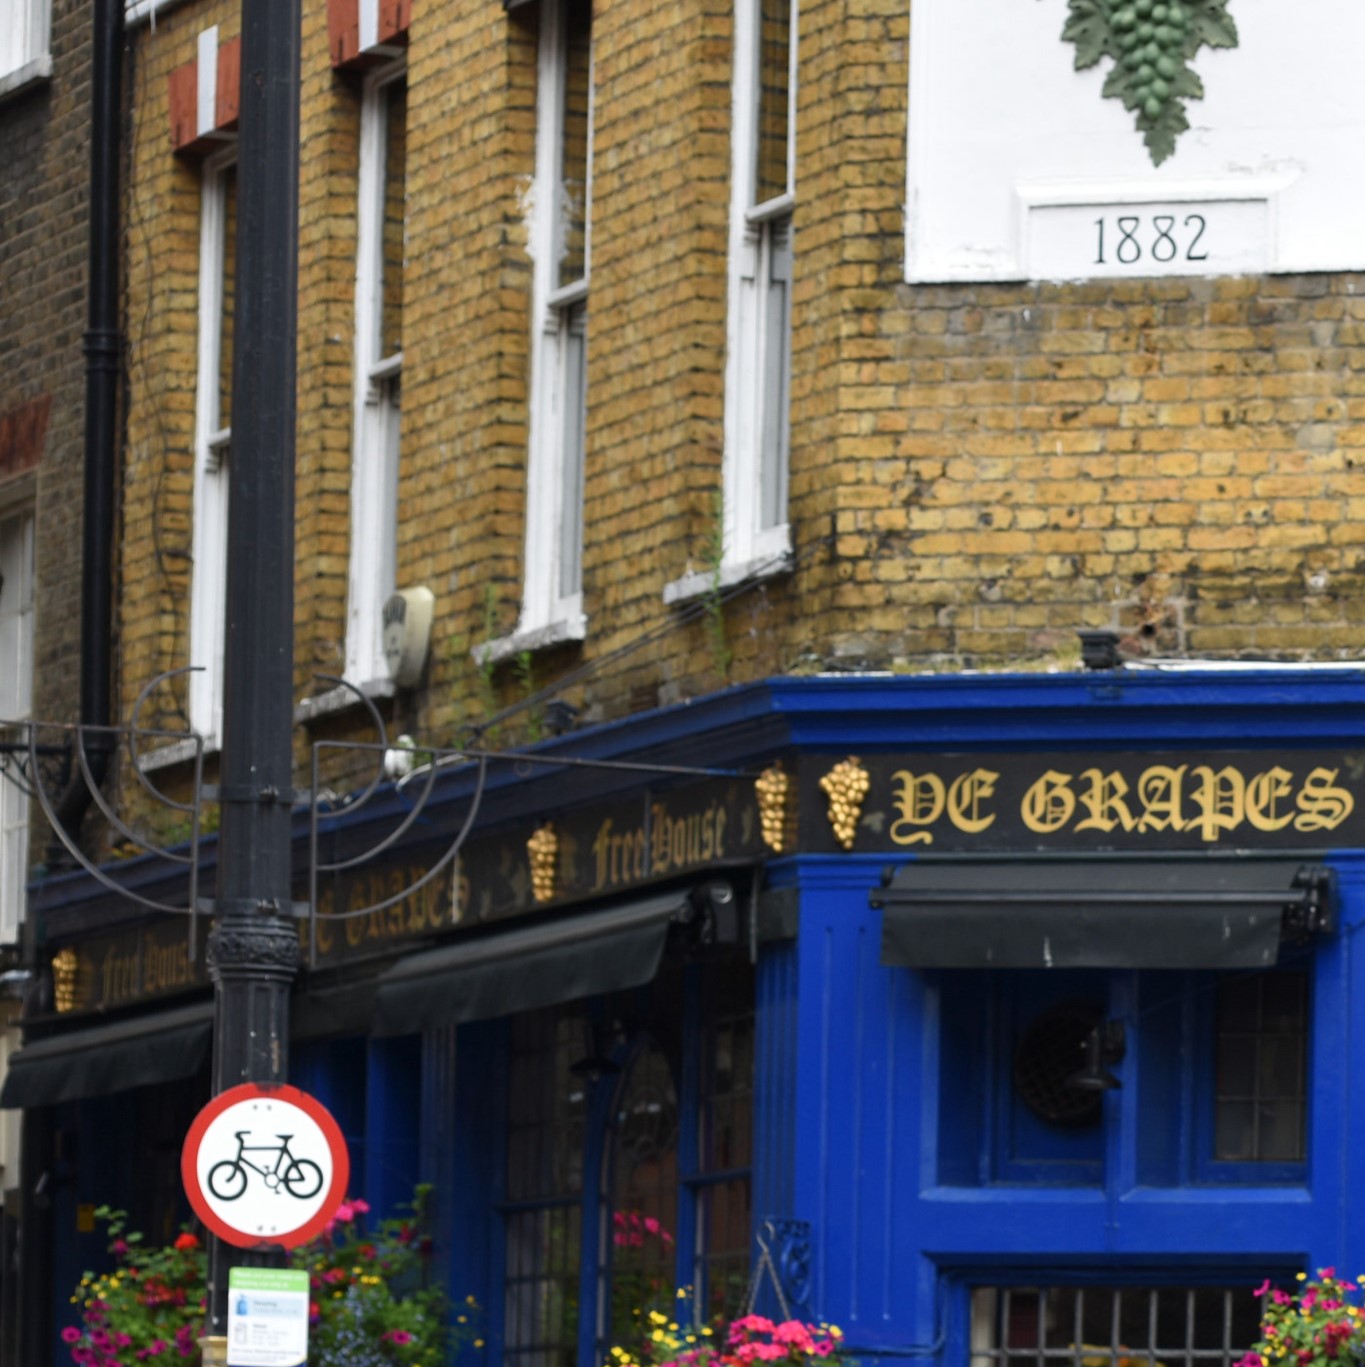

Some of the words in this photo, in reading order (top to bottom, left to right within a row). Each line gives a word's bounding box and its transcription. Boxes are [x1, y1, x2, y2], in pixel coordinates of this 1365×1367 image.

[1094, 214, 1208, 264] 1882
[890, 767, 999, 845] YE
[1020, 764, 1355, 841] GRAPES
